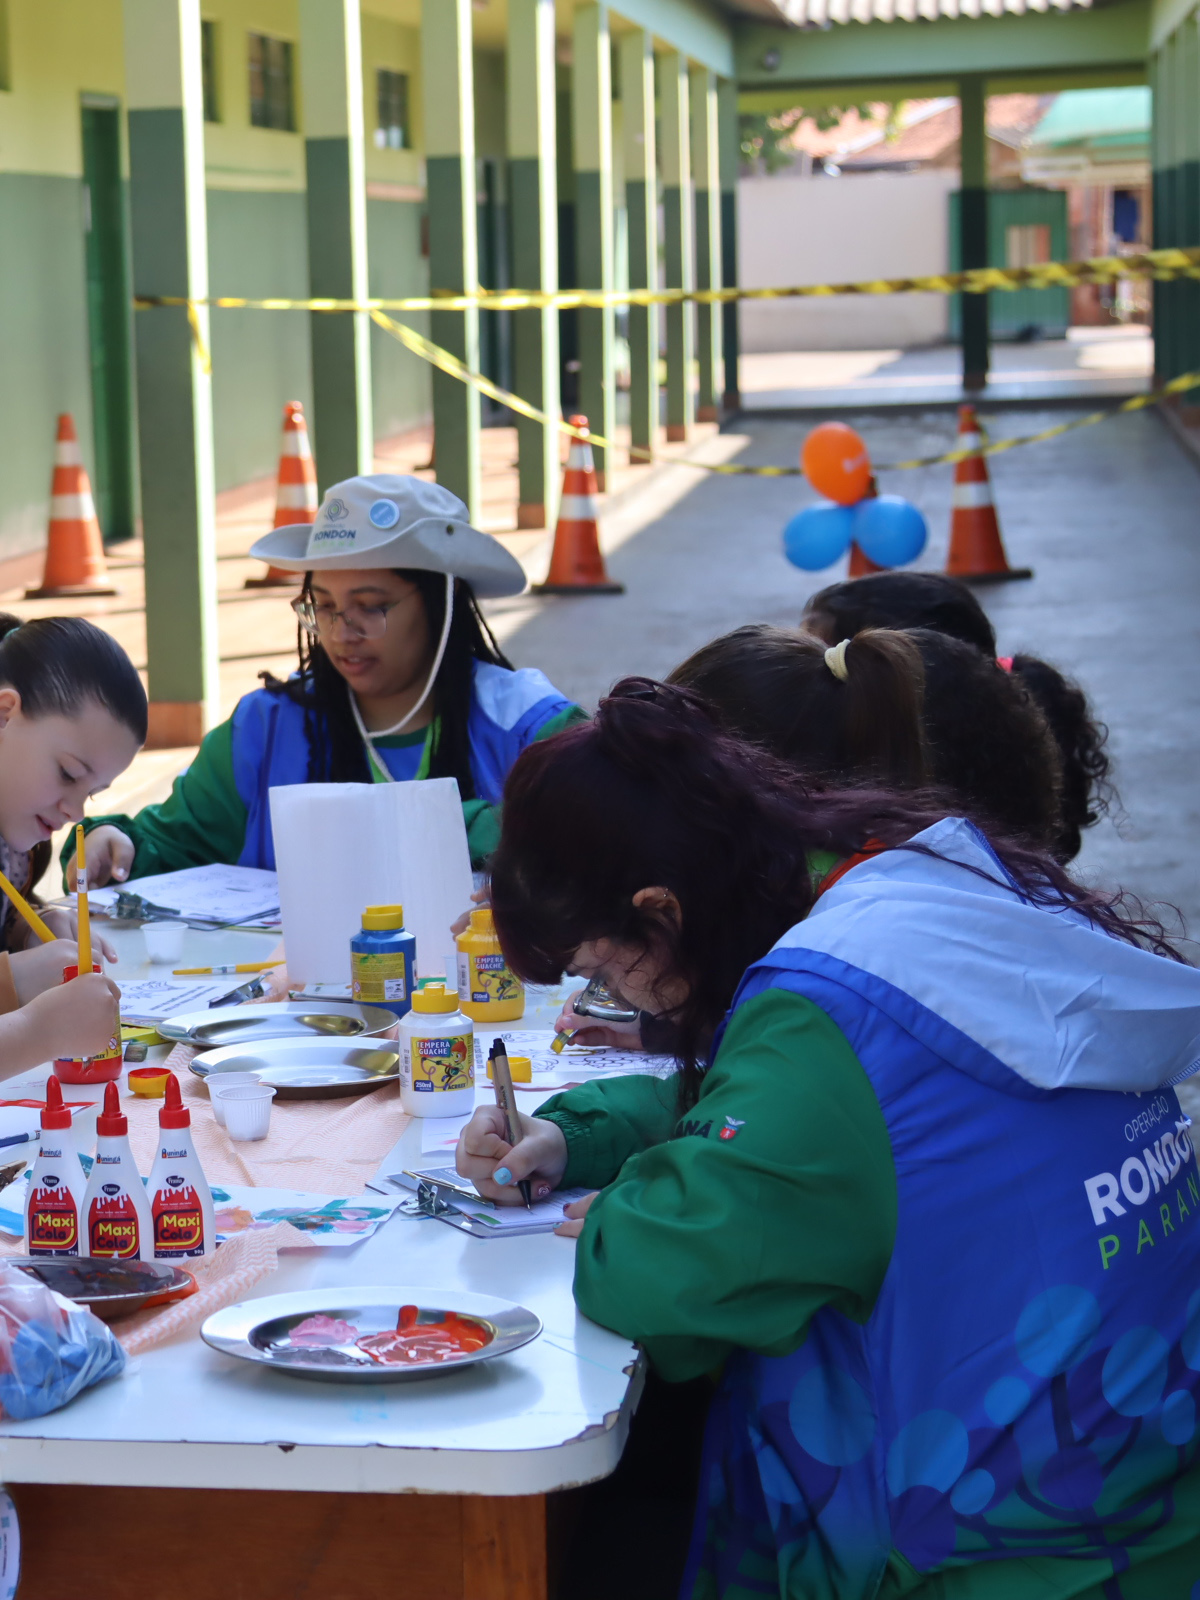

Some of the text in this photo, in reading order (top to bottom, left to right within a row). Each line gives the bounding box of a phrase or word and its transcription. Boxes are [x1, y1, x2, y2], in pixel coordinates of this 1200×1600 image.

[1124, 1096, 1169, 1142] OPERAÇÃO
[676, 1120, 714, 1138] ANÁ
[38, 1213, 74, 1227] Maxi
[163, 1213, 200, 1228] Maxi
[1098, 1172, 1200, 1270] PARAN
[36, 1227, 67, 1240] Cola
[99, 1222, 136, 1236] Maxi
[160, 1228, 193, 1240] Cola
[96, 1236, 128, 1249] Cola
